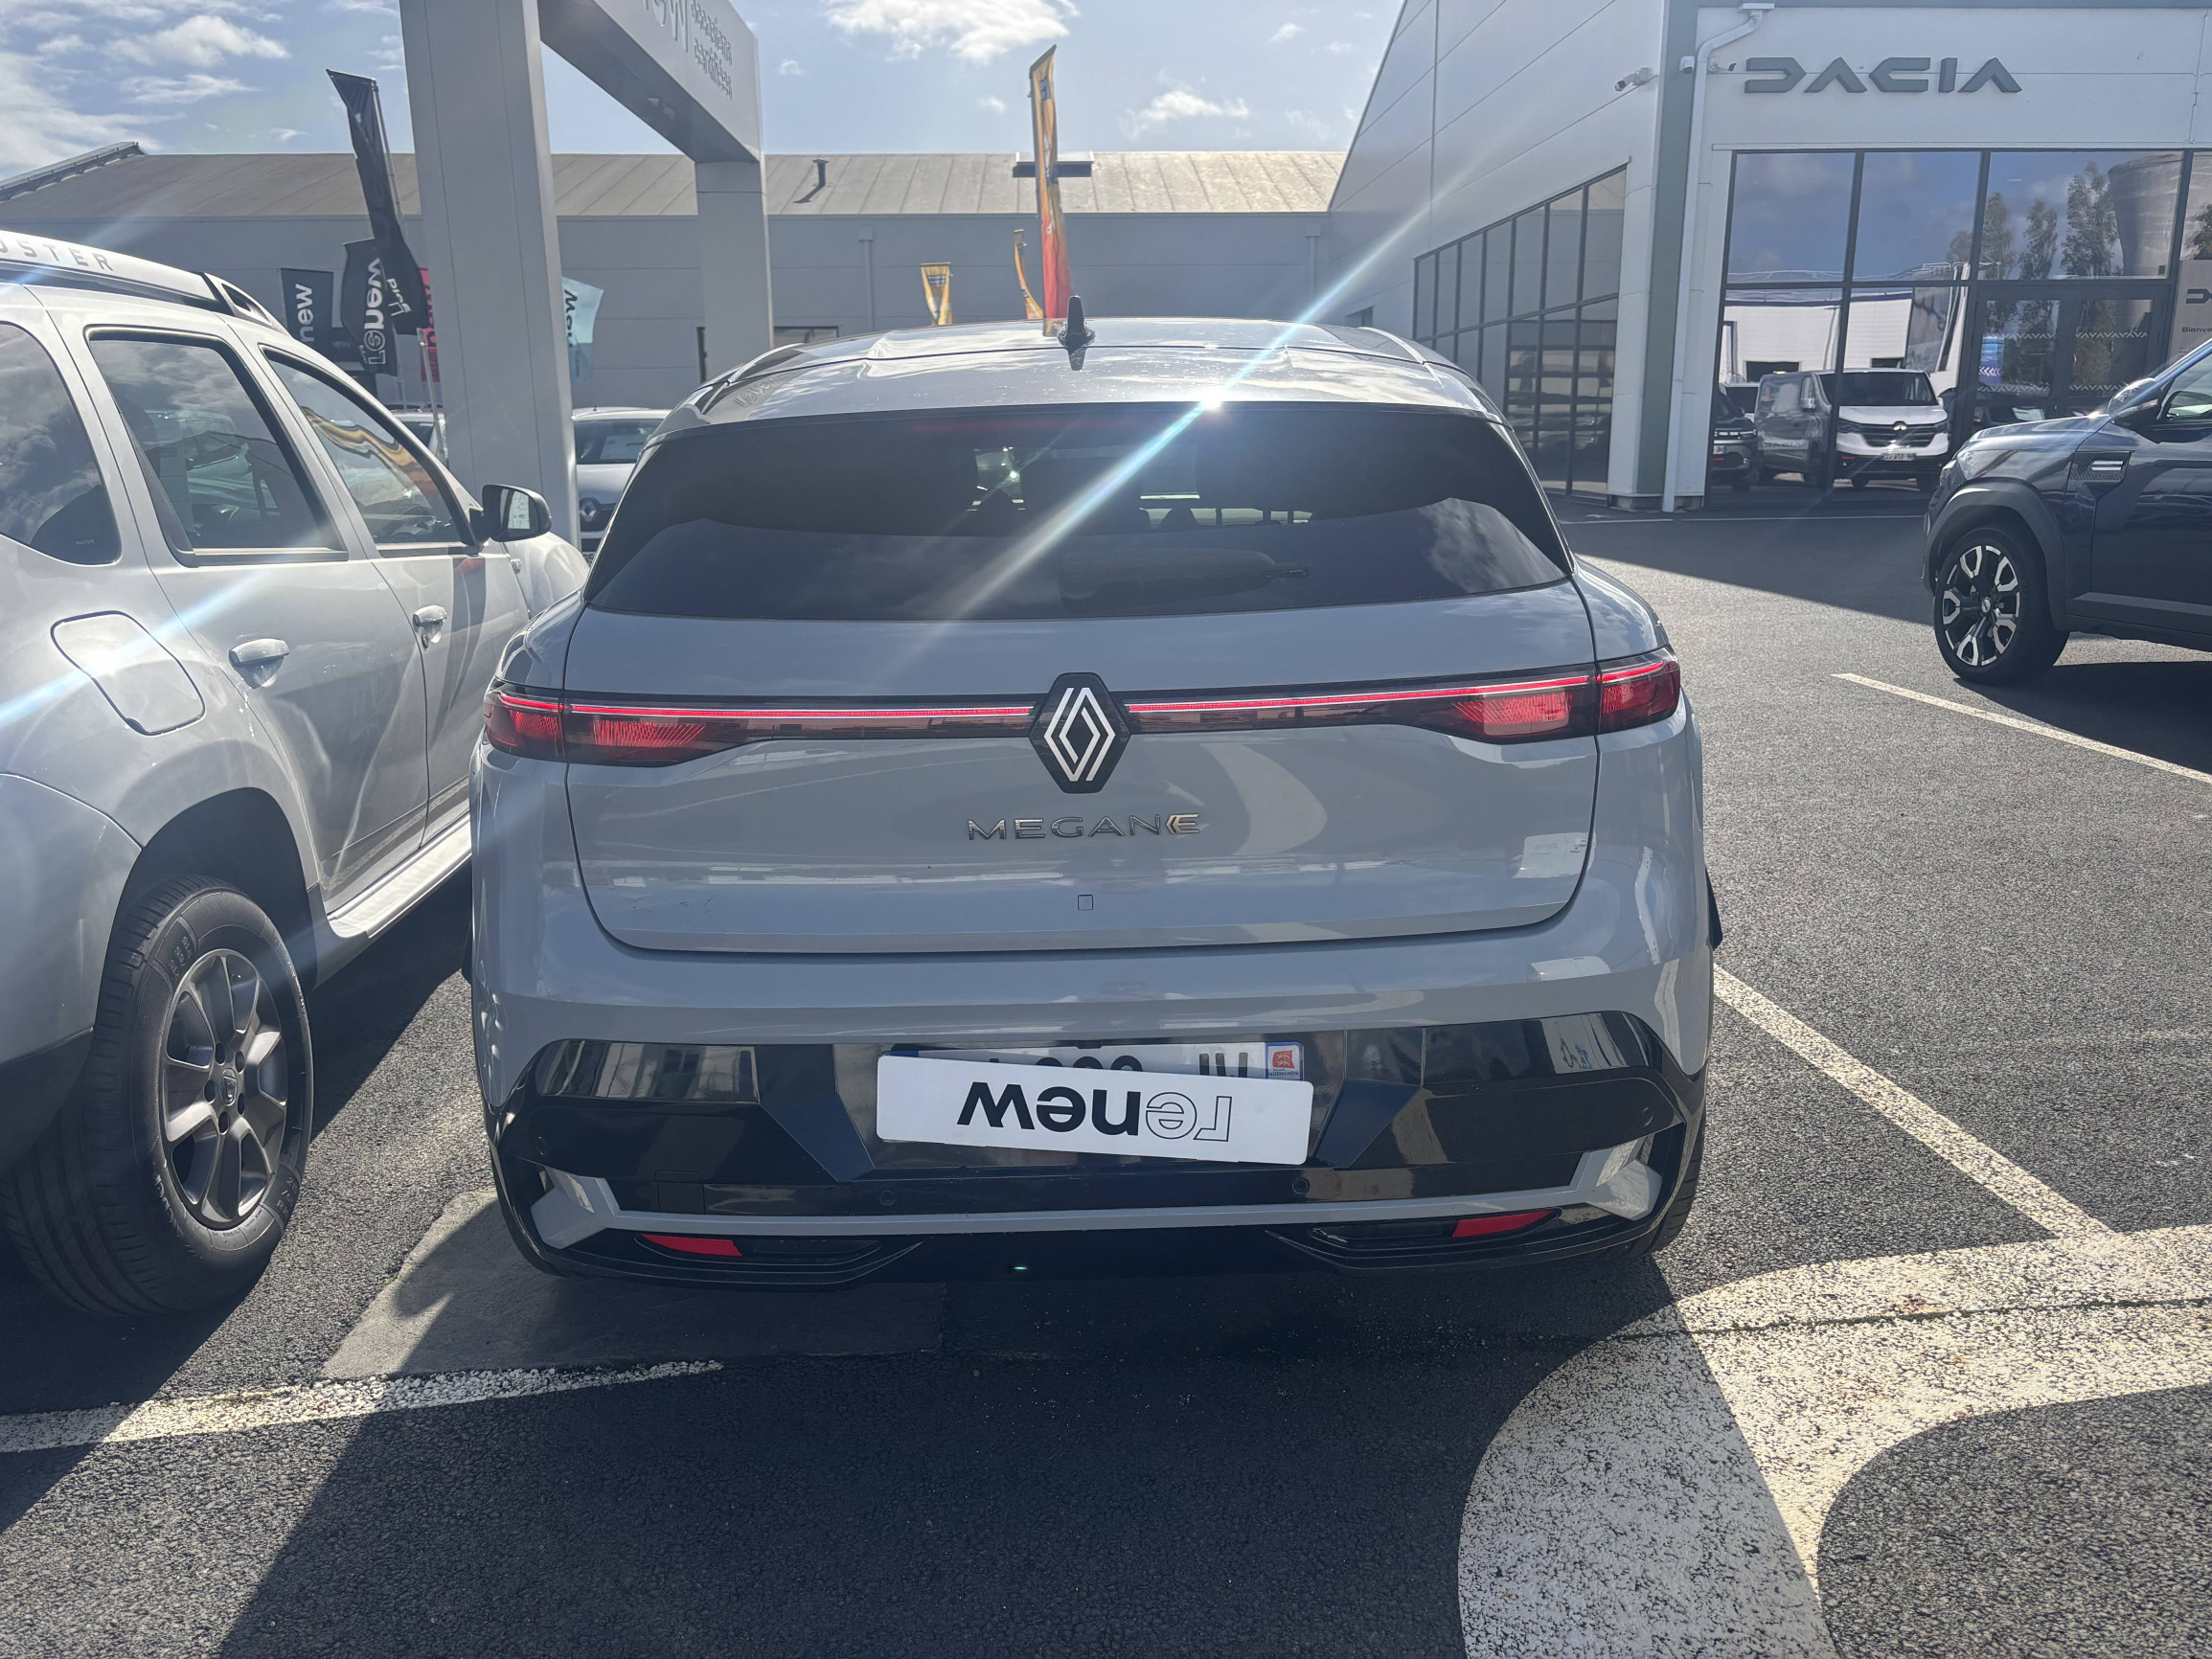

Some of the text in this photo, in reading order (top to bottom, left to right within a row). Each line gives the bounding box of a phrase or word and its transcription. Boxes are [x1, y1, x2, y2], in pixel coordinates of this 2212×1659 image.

[1744, 57, 2022, 93] DACIA
[363, 258, 386, 365] renew
[967, 813, 1200, 841] MEGANE
[956, 1080, 1233, 1143] renew
